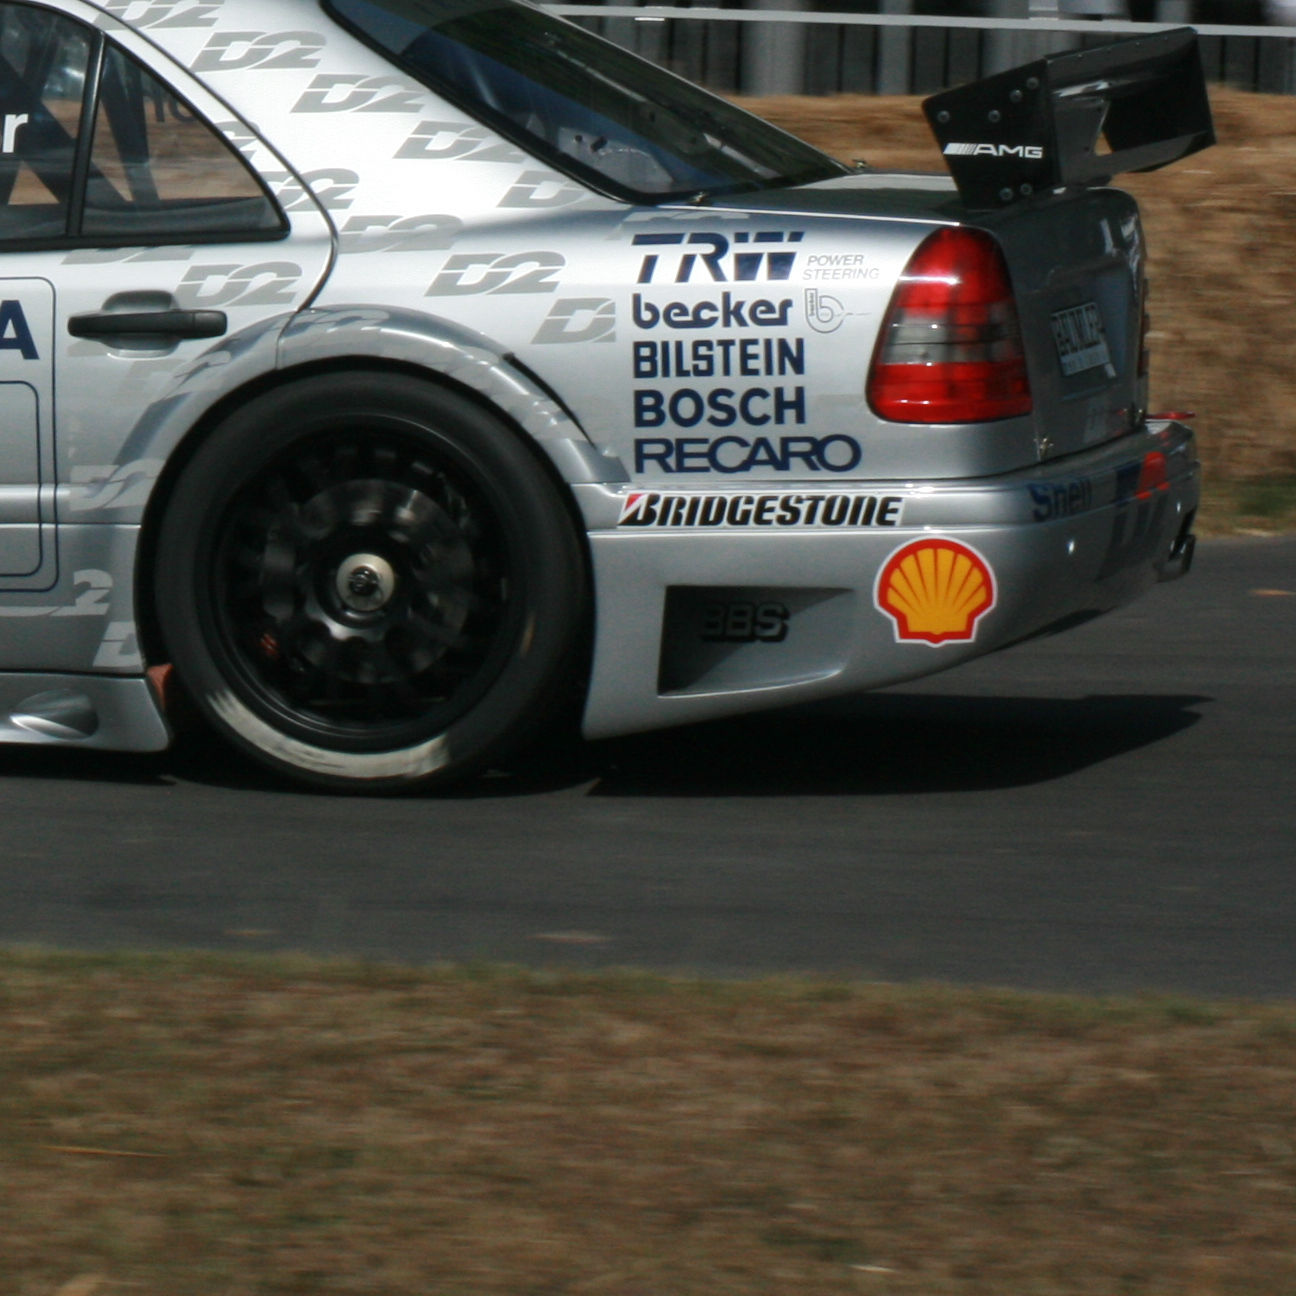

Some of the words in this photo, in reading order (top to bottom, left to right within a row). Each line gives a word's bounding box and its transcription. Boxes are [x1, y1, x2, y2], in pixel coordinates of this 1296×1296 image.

[190, 30, 327, 72] D2
[290, 73, 426, 113] D2
[973, 143, 1043, 159] AMG
[332, 213, 464, 255] D2
[424, 251, 566, 297] D2
[631, 231, 806, 284] TRW
[802, 267, 880, 281] STEERING
[807, 254, 864, 267] POWER
[174, 261, 303, 307] D2
[530, 297, 616, 344] D
[632, 292, 793, 330] becker
[633, 338, 806, 379] BILSTEIN
[634, 386, 807, 428] BOSCH
[634, 433, 862, 474] RECARO
[617, 493, 903, 527] BRIDGESTONE
